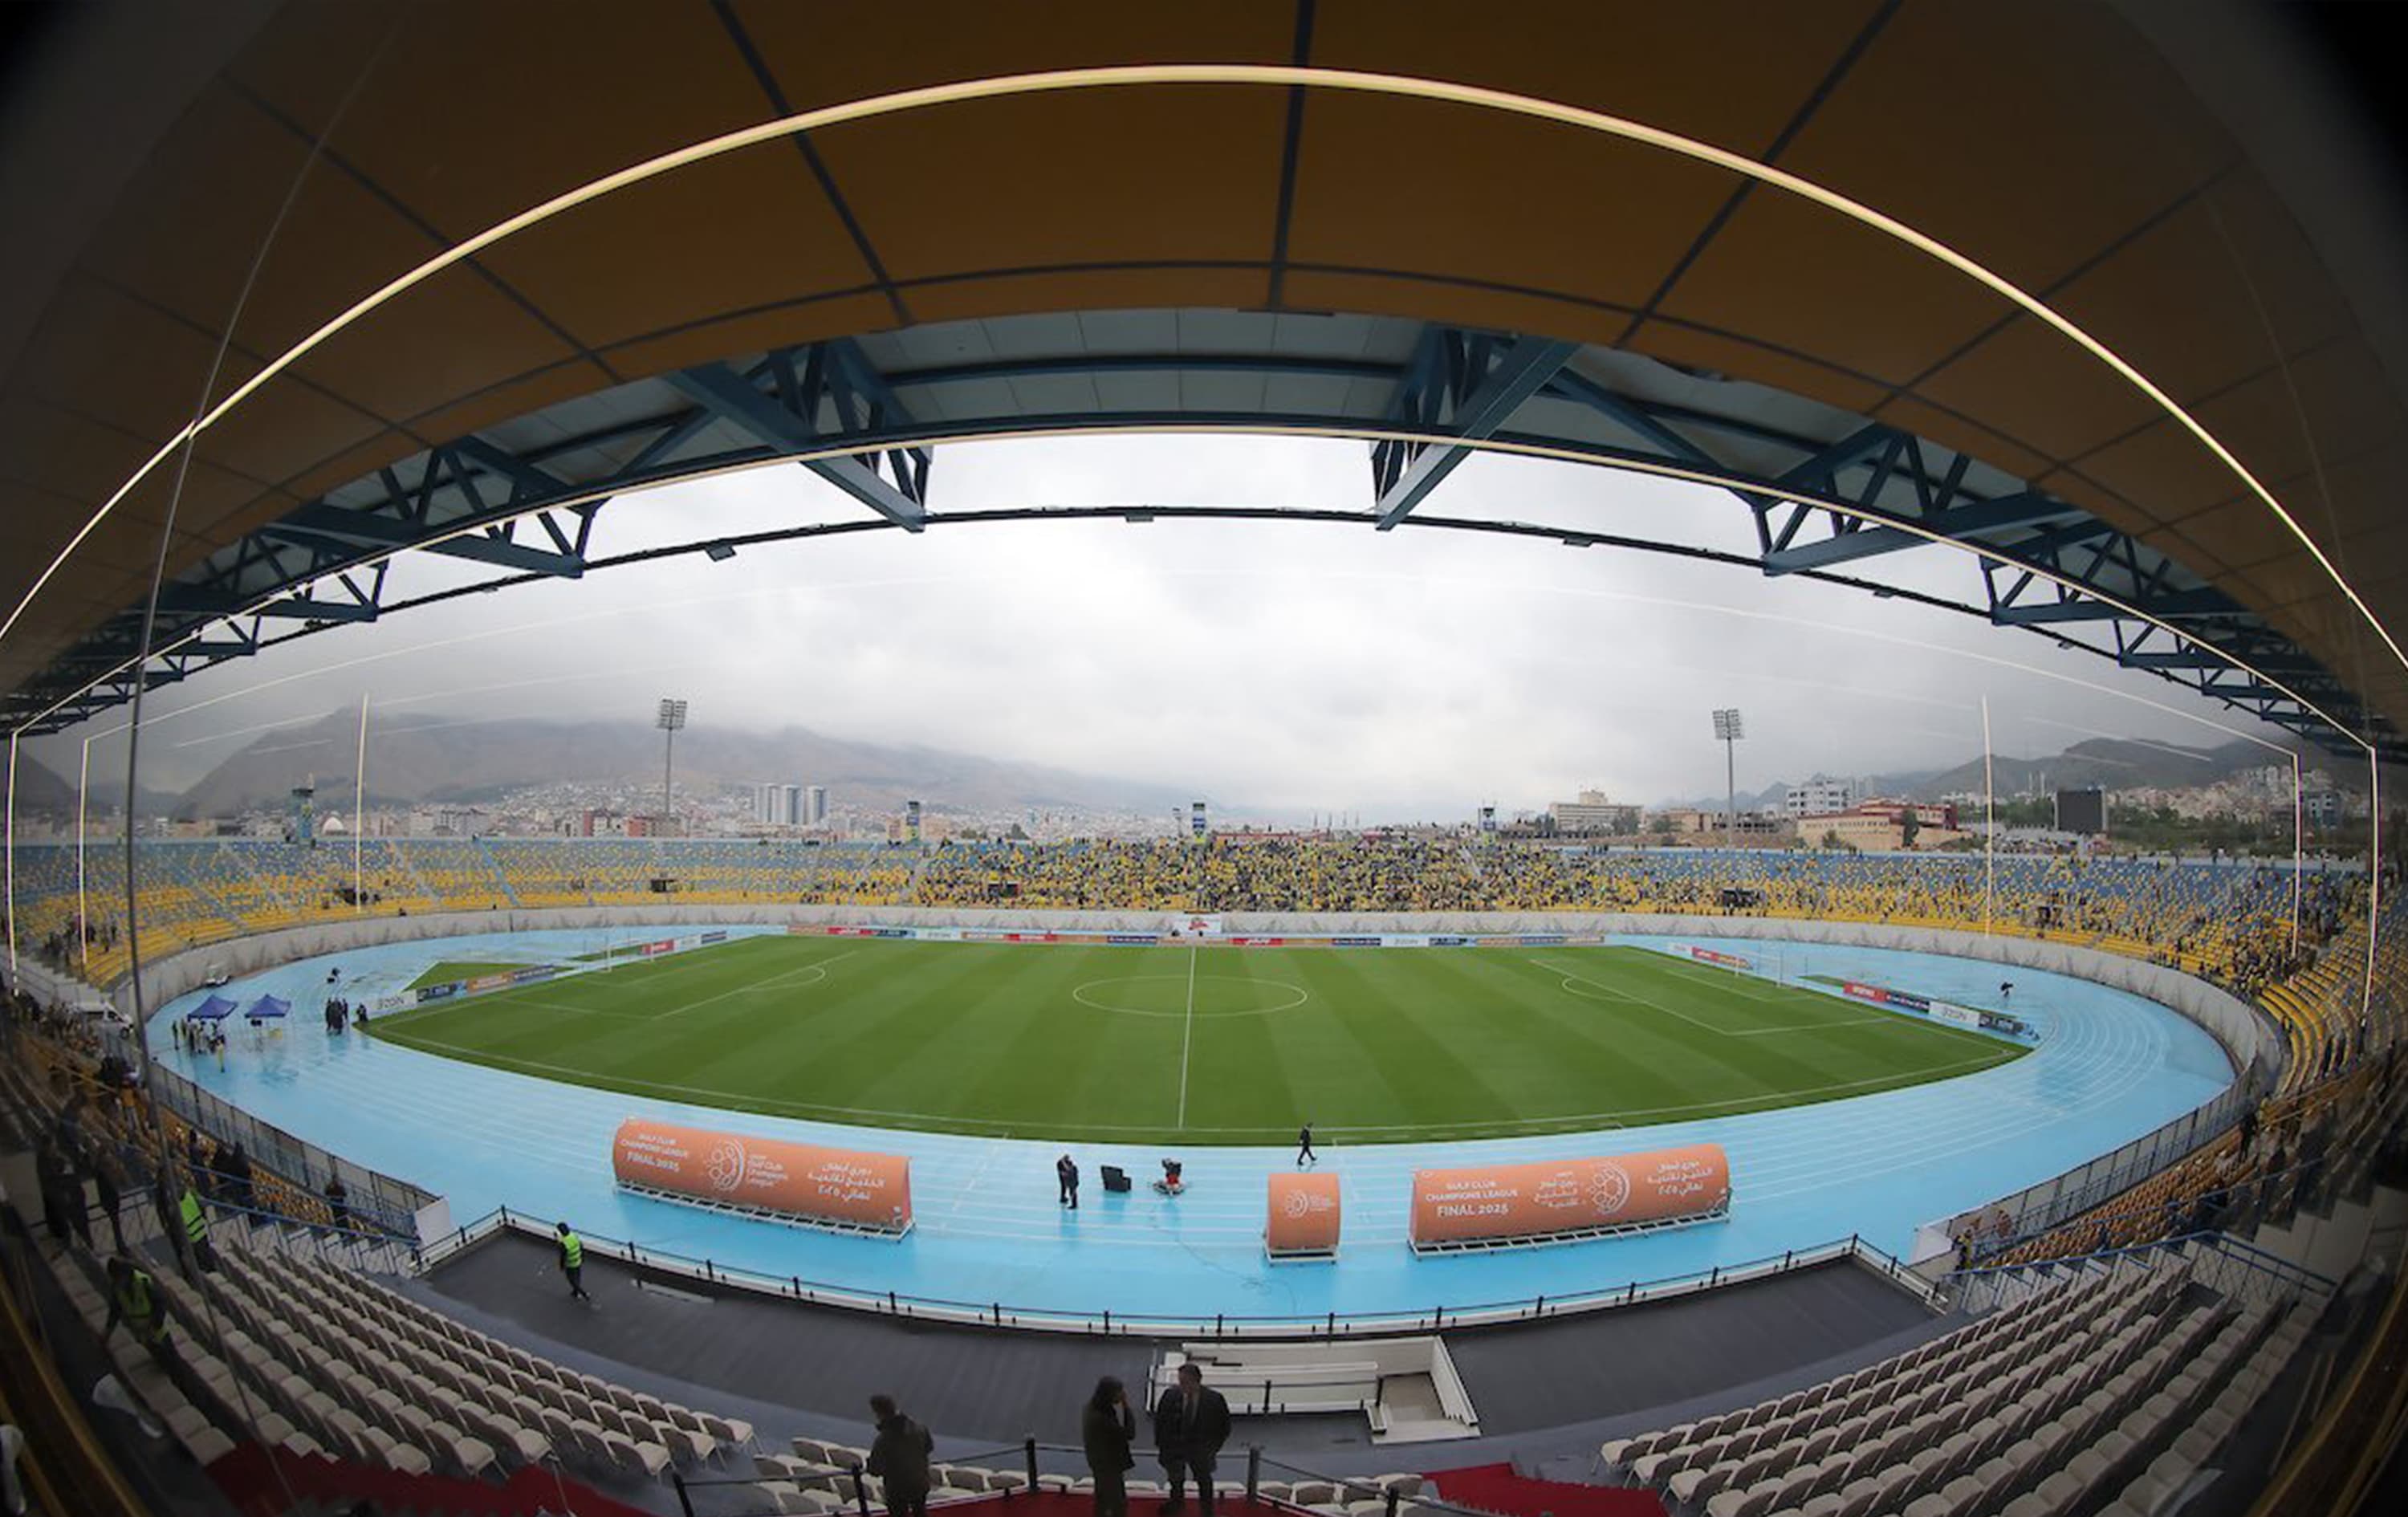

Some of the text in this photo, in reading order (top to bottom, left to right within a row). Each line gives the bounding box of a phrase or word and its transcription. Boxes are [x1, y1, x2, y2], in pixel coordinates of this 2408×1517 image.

[627, 1151, 656, 1165] FINAL
[1446, 1181, 1498, 1190] GULF CLUB
[1425, 1188, 1519, 1202] CHAMPIONS LEAGUE
[1437, 1202, 1509, 1218] FINAL 2025
